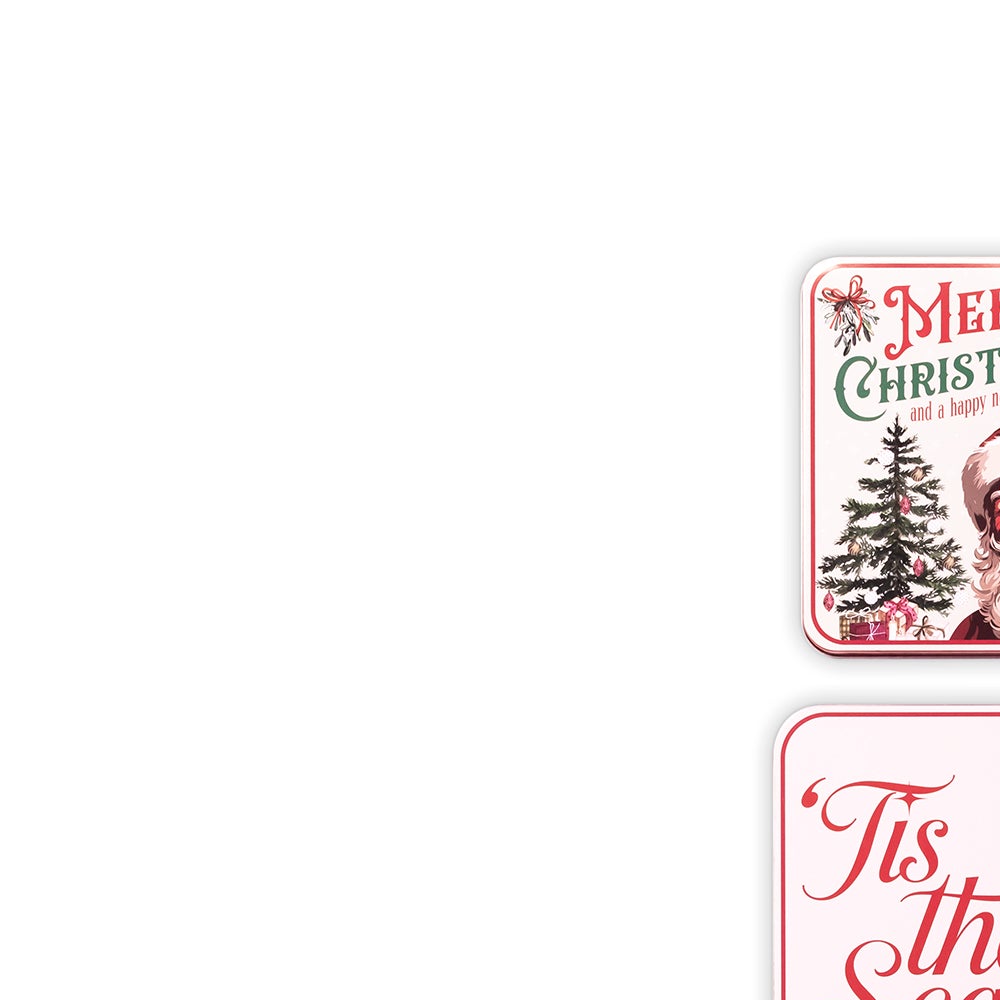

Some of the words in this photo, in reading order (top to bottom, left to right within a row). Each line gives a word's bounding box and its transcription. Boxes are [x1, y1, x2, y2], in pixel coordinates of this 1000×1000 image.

[910, 400, 932, 422] and
[937, 403, 945, 419] a
[950, 394, 987, 418] happy
